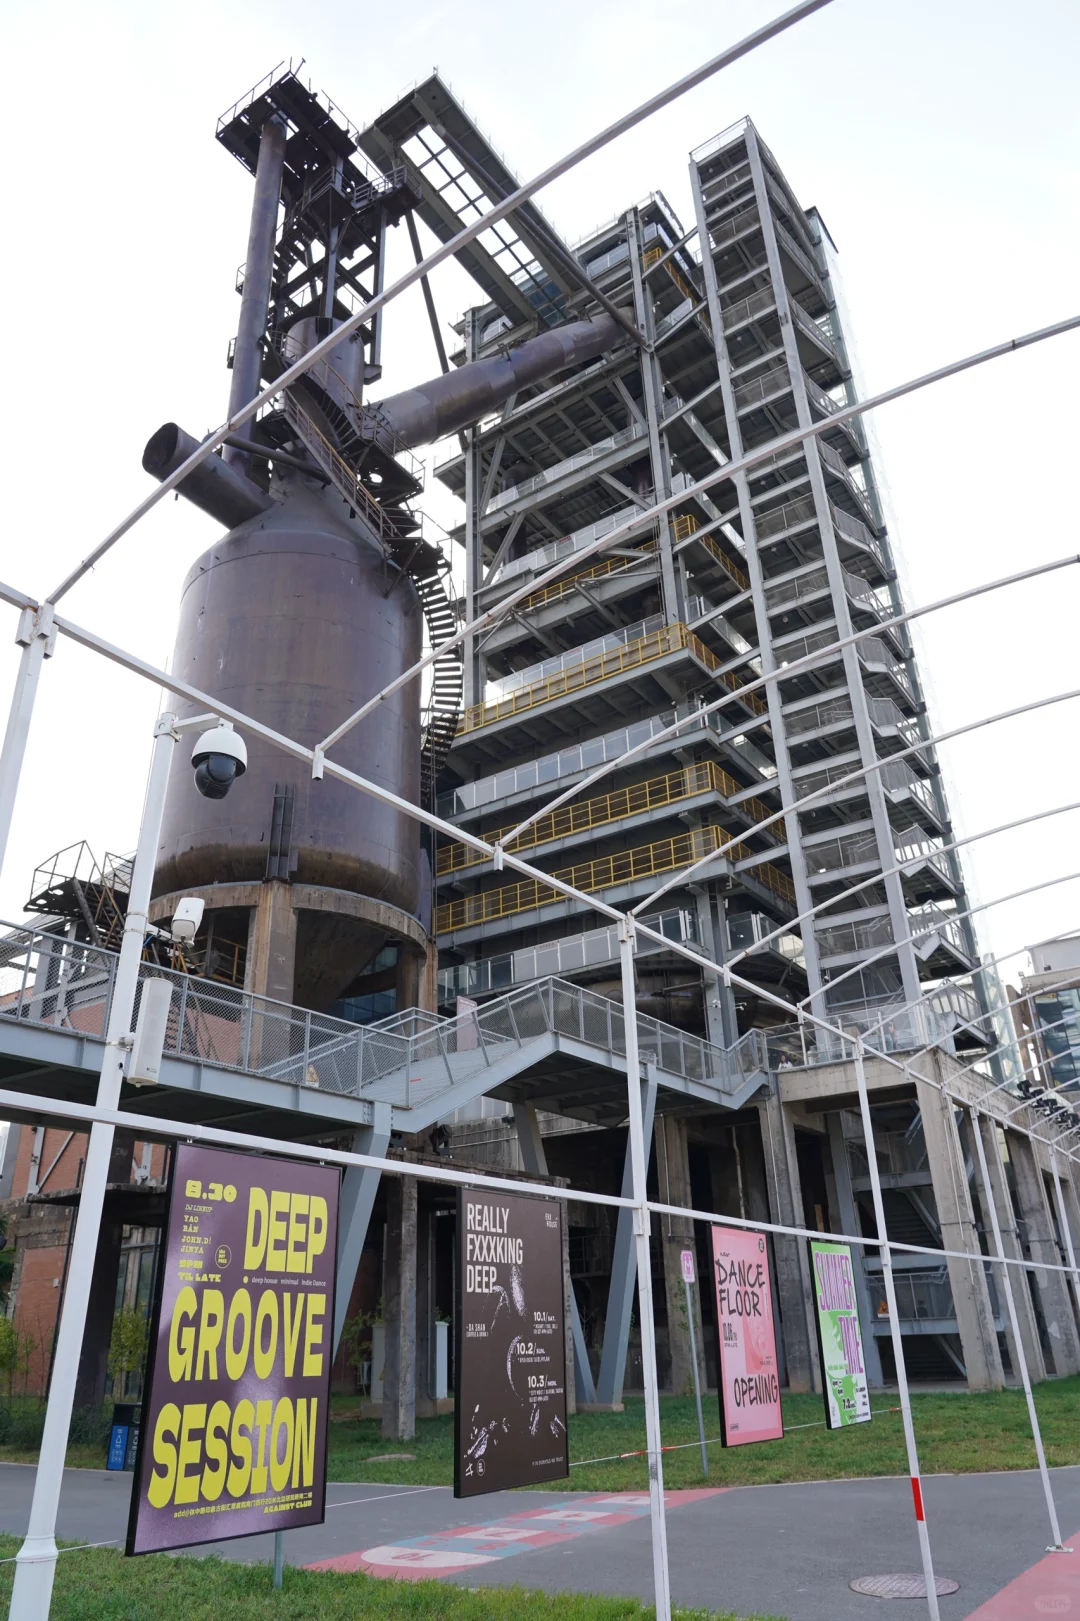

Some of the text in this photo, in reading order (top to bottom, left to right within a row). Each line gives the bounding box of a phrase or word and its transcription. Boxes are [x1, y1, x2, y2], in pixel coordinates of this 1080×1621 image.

[185, 1179, 237, 1203] 8.30
[184, 1214, 199, 1223] YAO
[244, 1187, 328, 1274] DEEP
[467, 1203, 509, 1233] REALLY
[467, 1233, 523, 1265] FXXXKING
[195, 1273, 221, 1283] LATE
[251, 1277, 263, 1285] deep
[466, 1265, 497, 1293] DEEP
[715, 1259, 766, 1288] DANCE
[815, 1252, 856, 1310] SUMMER
[718, 1288, 762, 1317] FLOOR
[168, 1286, 326, 1382] GROOVE
[838, 1317, 863, 1375] TIME
[734, 1374, 778, 1408] OPENING
[147, 1396, 318, 1509] SESSION
[263, 1500, 313, 1514] AGAINST CLUB
